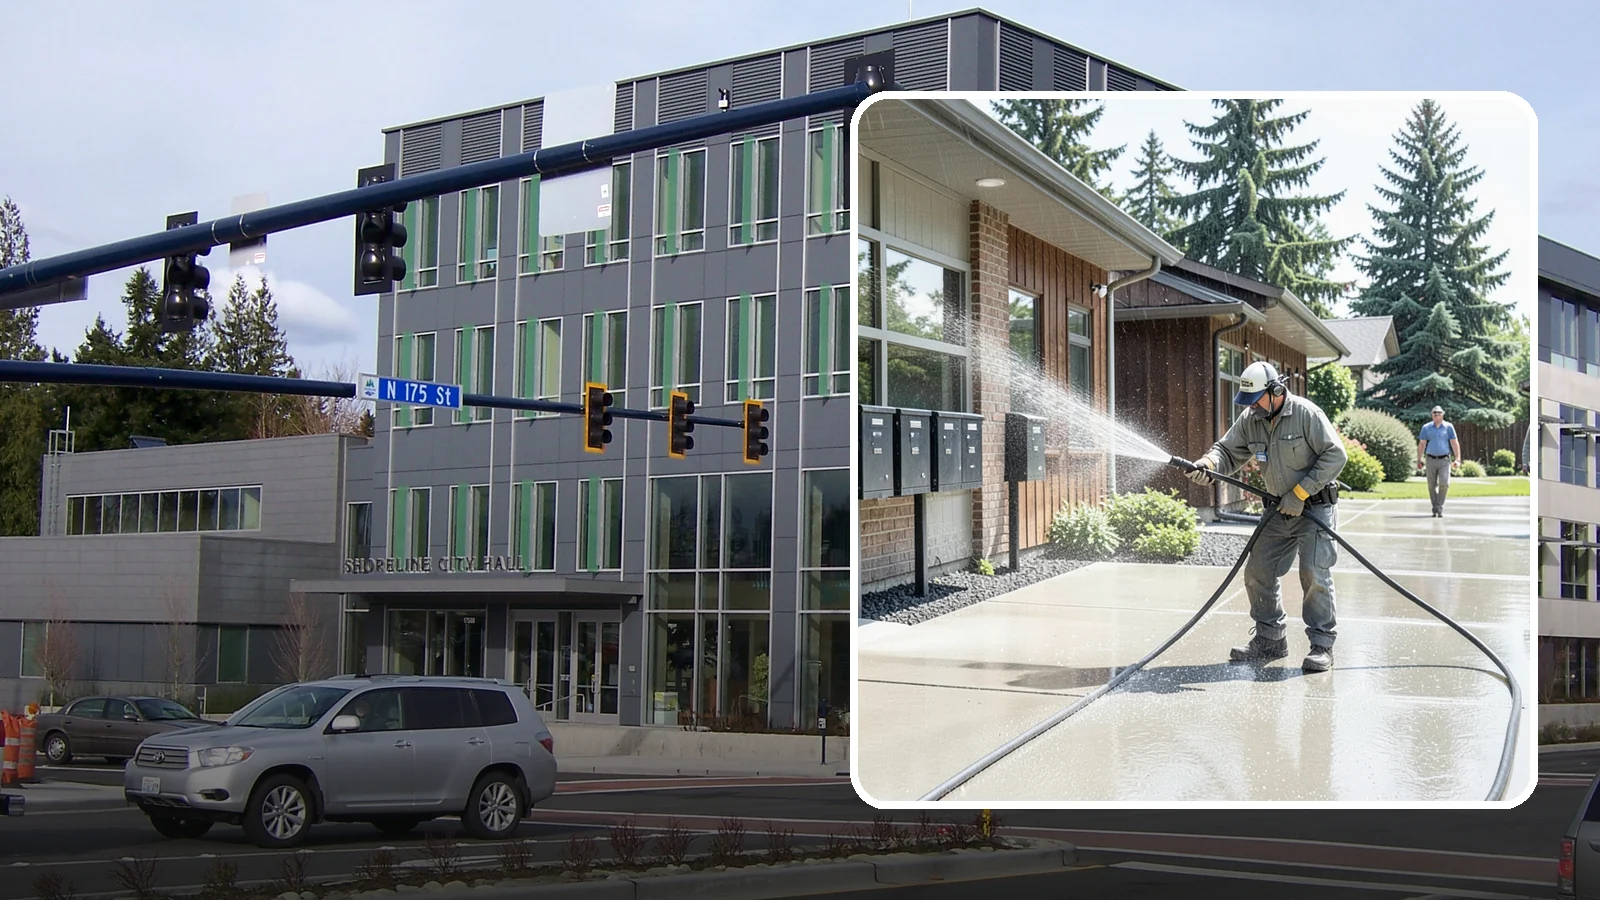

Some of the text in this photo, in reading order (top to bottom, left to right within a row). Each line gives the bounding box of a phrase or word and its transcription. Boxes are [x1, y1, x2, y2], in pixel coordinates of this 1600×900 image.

[387, 380, 451, 406] N 175 St
[344, 555, 526, 574] SHORELINE CITY HALL
